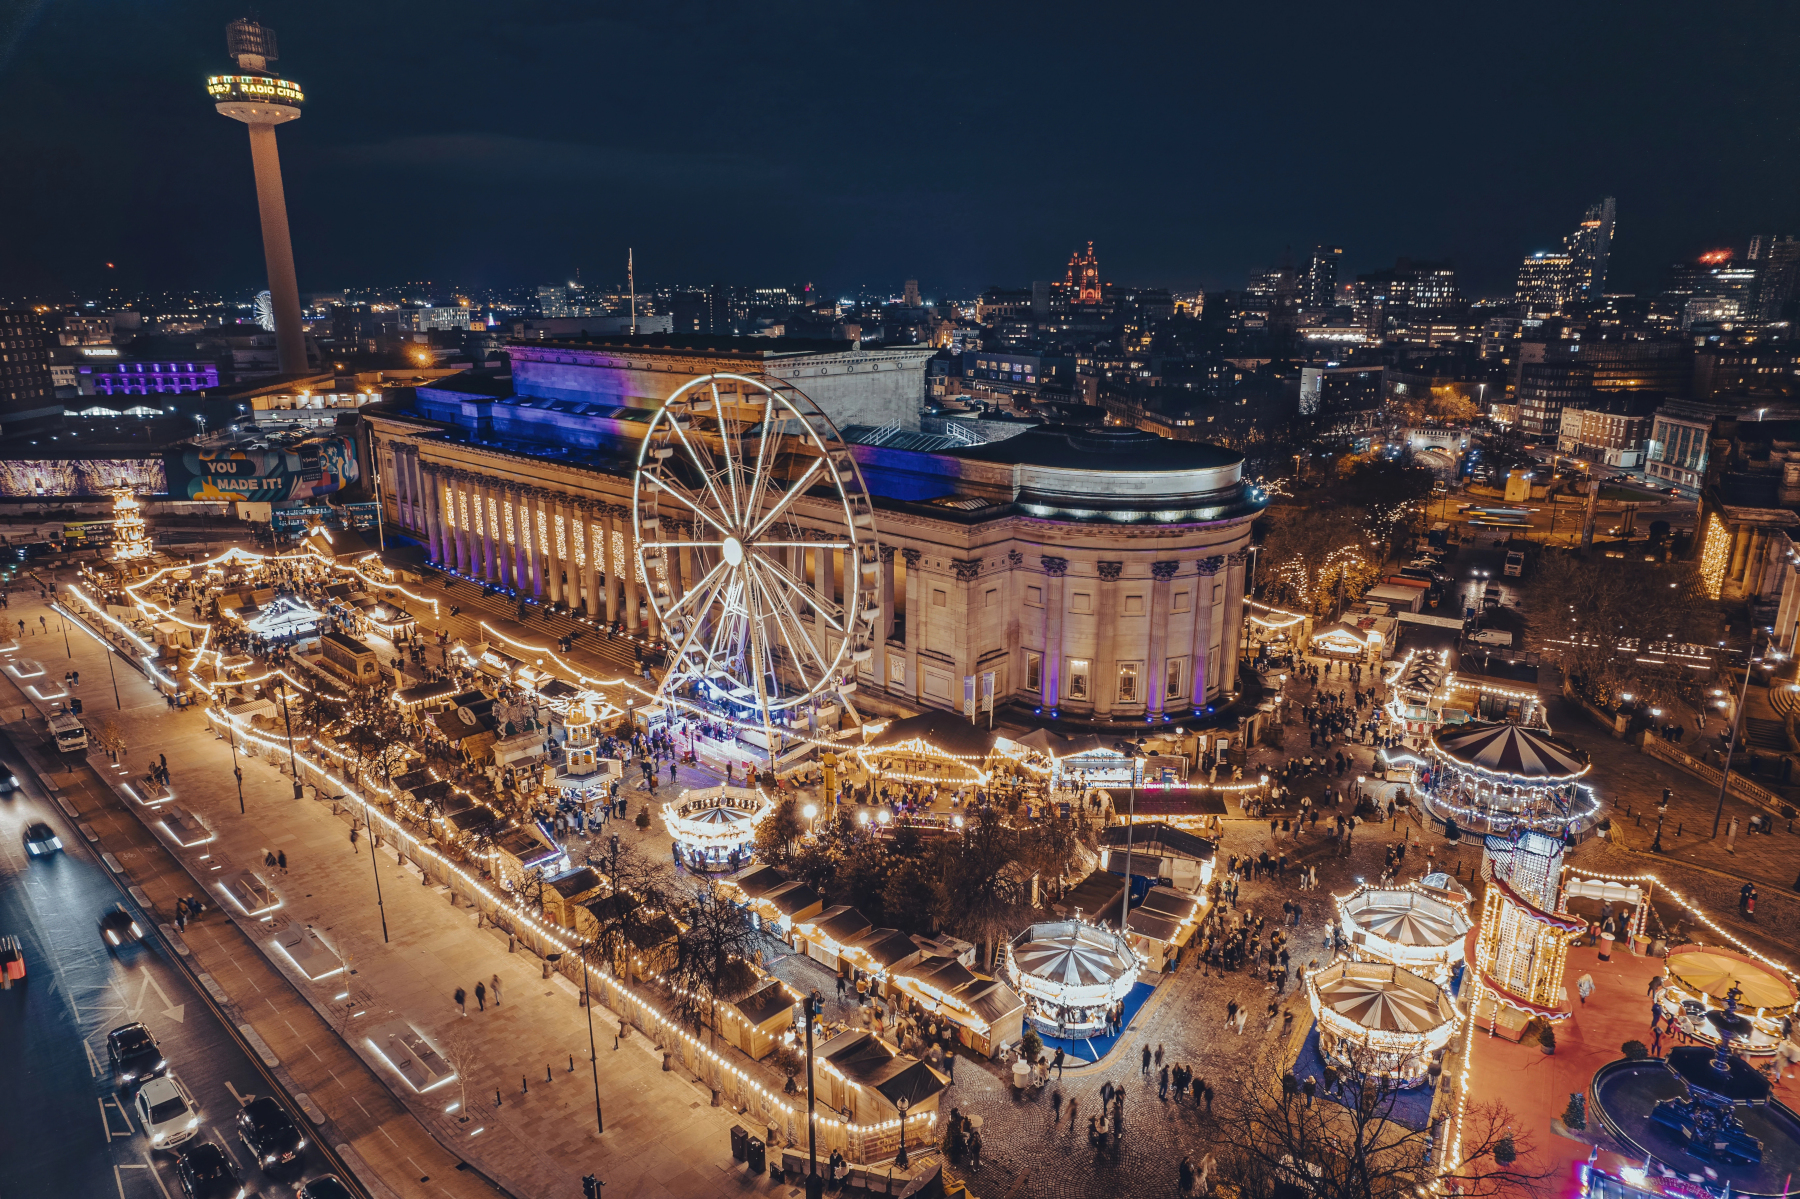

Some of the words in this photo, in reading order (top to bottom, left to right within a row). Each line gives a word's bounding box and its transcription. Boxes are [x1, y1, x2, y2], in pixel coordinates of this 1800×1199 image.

[241, 84, 275, 95] RADIO
[277, 87, 296, 98] CITY
[207, 462, 237, 474] YOU
[217, 479, 259, 490] MADE
[262, 477, 282, 490] IT!
